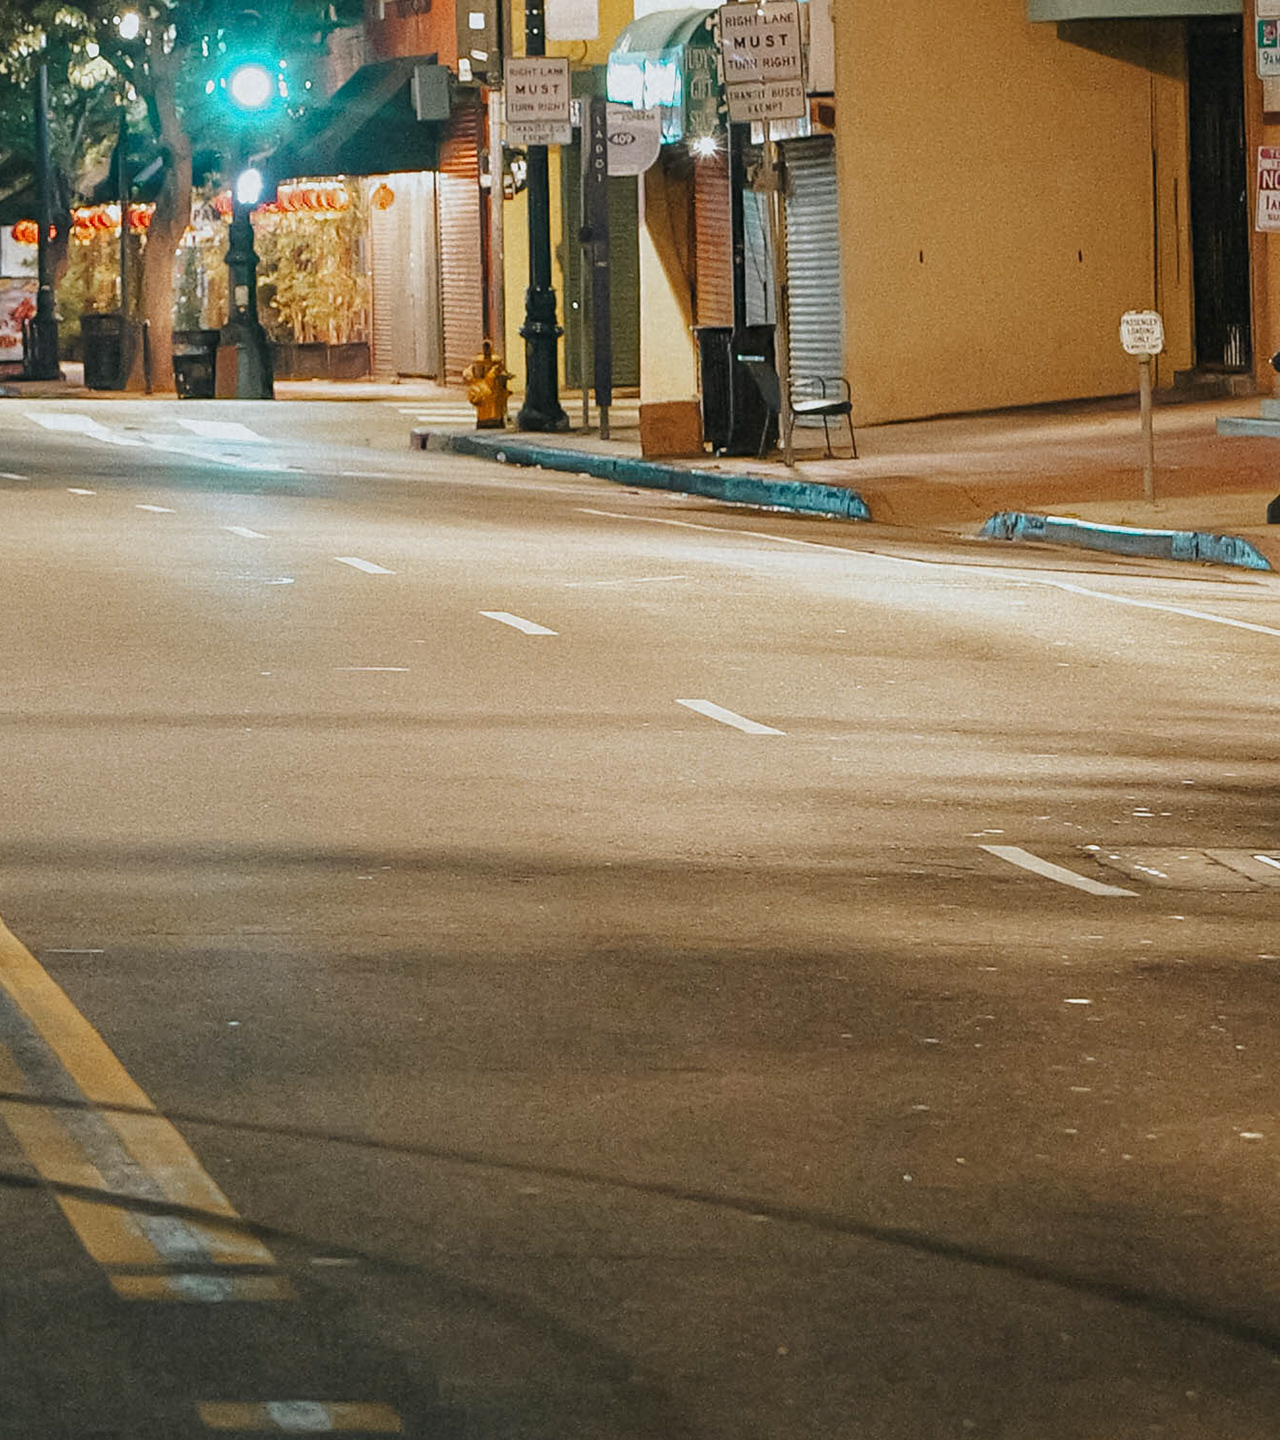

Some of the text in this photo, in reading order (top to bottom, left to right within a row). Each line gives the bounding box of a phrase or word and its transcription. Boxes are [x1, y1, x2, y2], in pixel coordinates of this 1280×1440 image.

[725, 12, 794, 27] RIGHT LANE
[734, 34, 788, 50] MUST
[728, 56, 797, 70] TURN RIGHT
[509, 68, 537, 77] RIGHT
[515, 84, 559, 95] MUST
[771, 88, 801, 97] BUSES
[511, 103, 565, 112] TURN RIGHT
